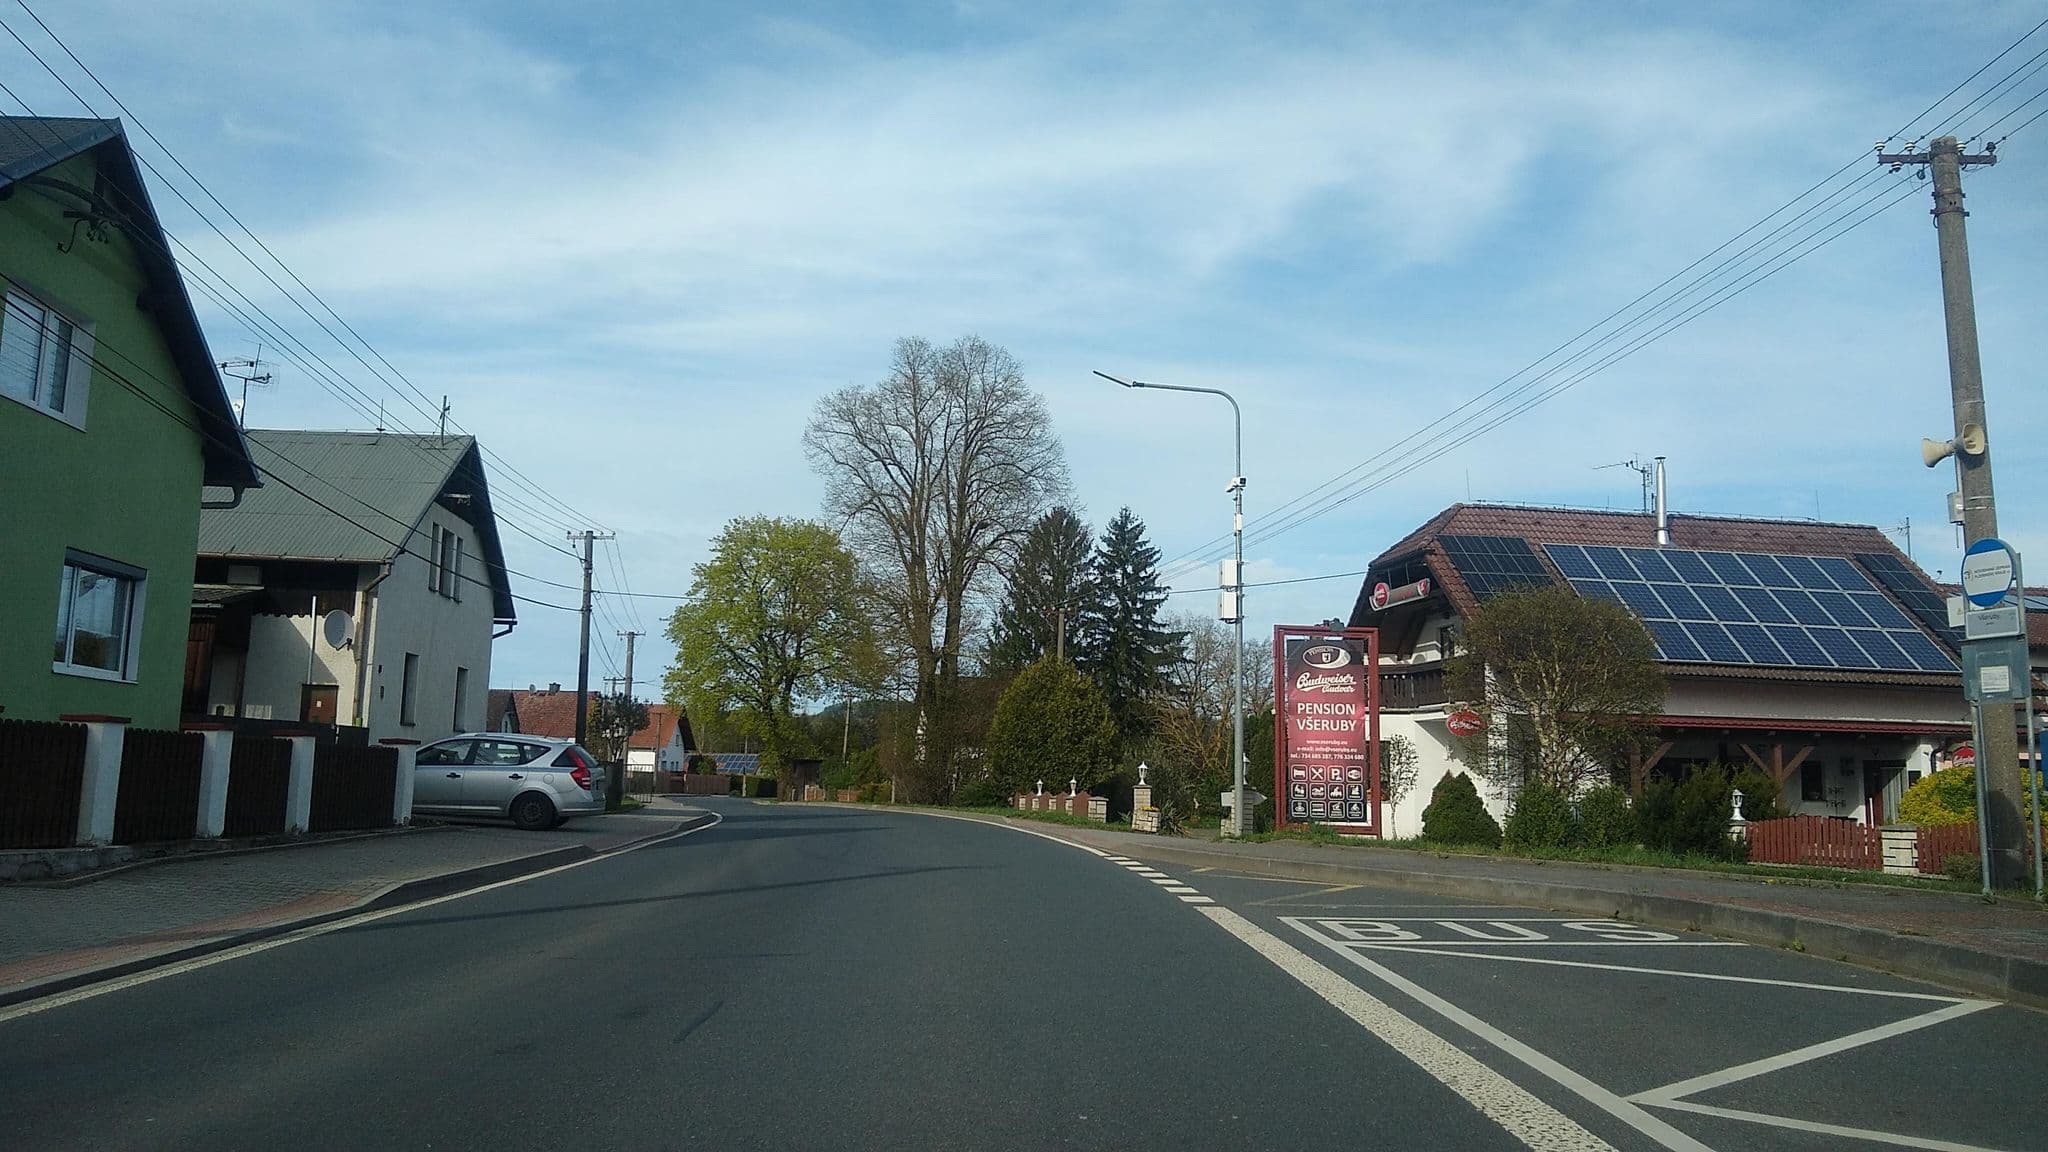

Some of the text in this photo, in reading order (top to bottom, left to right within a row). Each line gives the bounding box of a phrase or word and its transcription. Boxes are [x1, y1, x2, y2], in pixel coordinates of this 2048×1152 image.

[1296, 672, 1357, 691] Budweiser
[1297, 703, 1356, 715] PENSION
[1296, 716, 1357, 731] VŠERUBY
[1317, 919, 1680, 942] BUS
